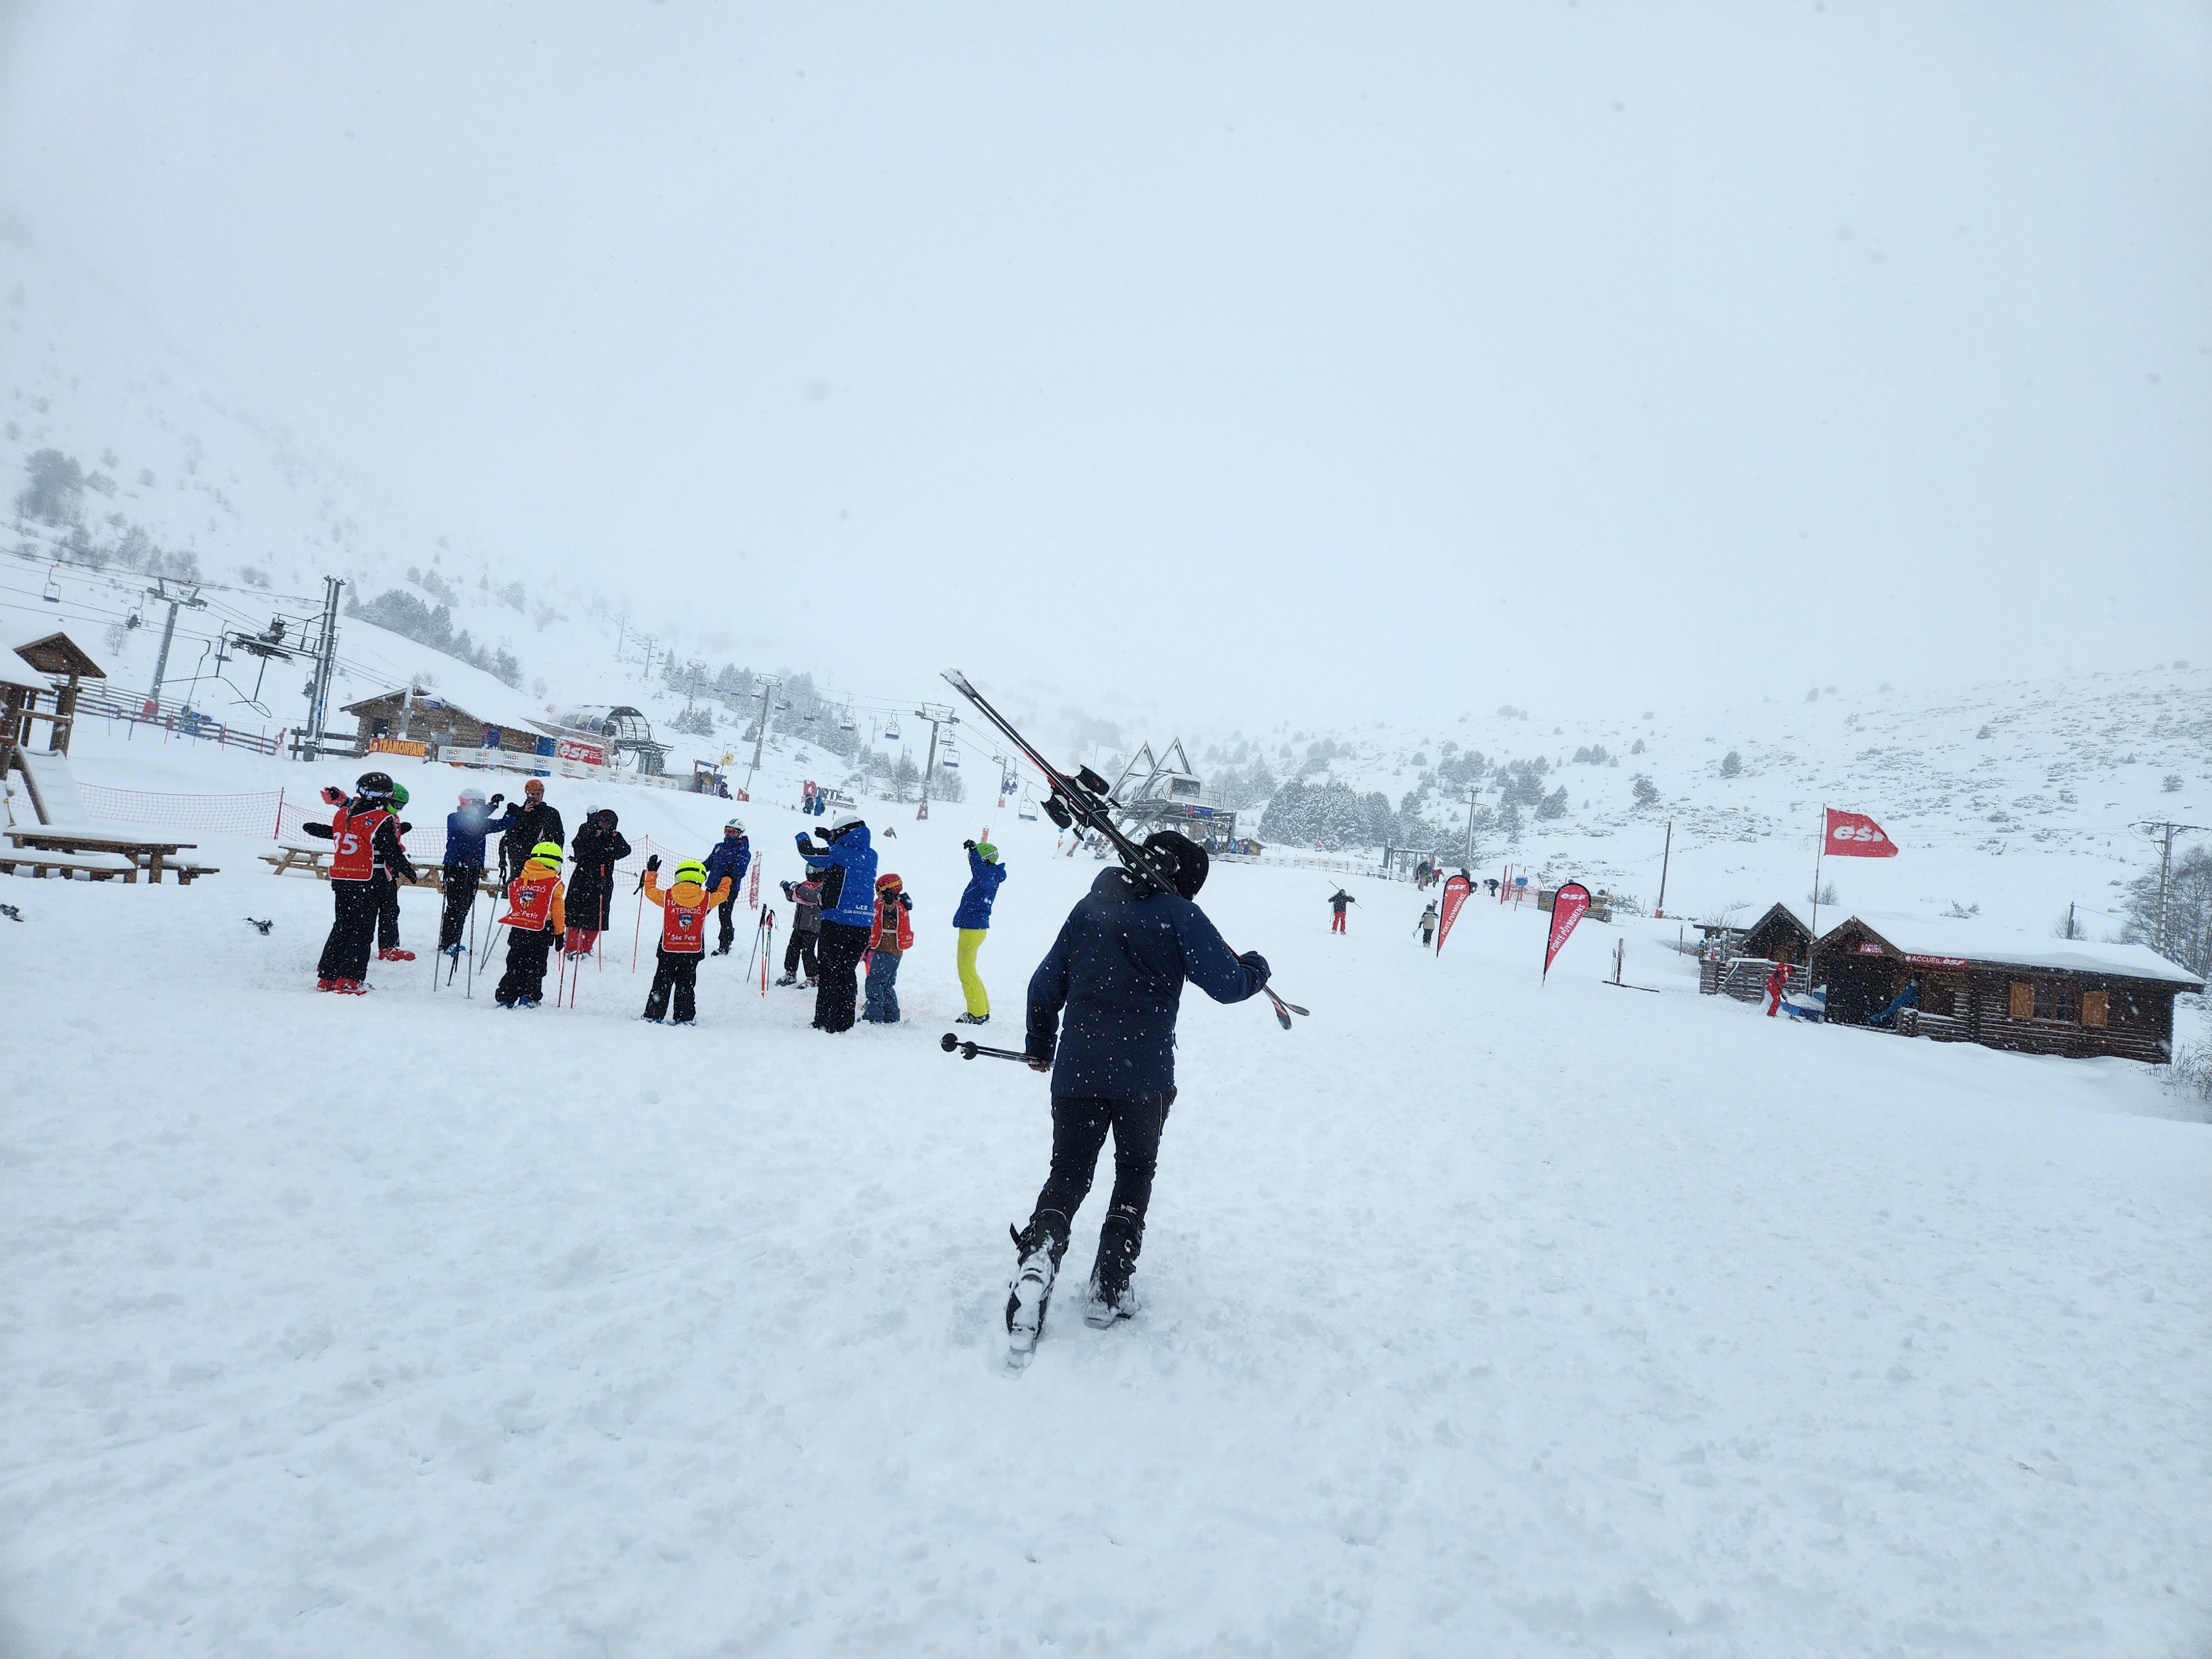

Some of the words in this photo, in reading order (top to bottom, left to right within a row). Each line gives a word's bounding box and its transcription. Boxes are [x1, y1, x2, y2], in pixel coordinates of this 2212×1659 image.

[379, 739, 426, 757] TRAMONTANE
[559, 744, 590, 760] esf
[516, 885, 546, 893] ATENCIÓ
[671, 906, 702, 915] ATENCIÓ
[1449, 893, 1467, 922] PUYMORENS
[521, 910, 539, 919] Petit
[1561, 904, 1585, 936] PUYMORENS
[1860, 943, 1884, 954] ACCUEIL
[1911, 956, 1942, 964] ACCUEIL
